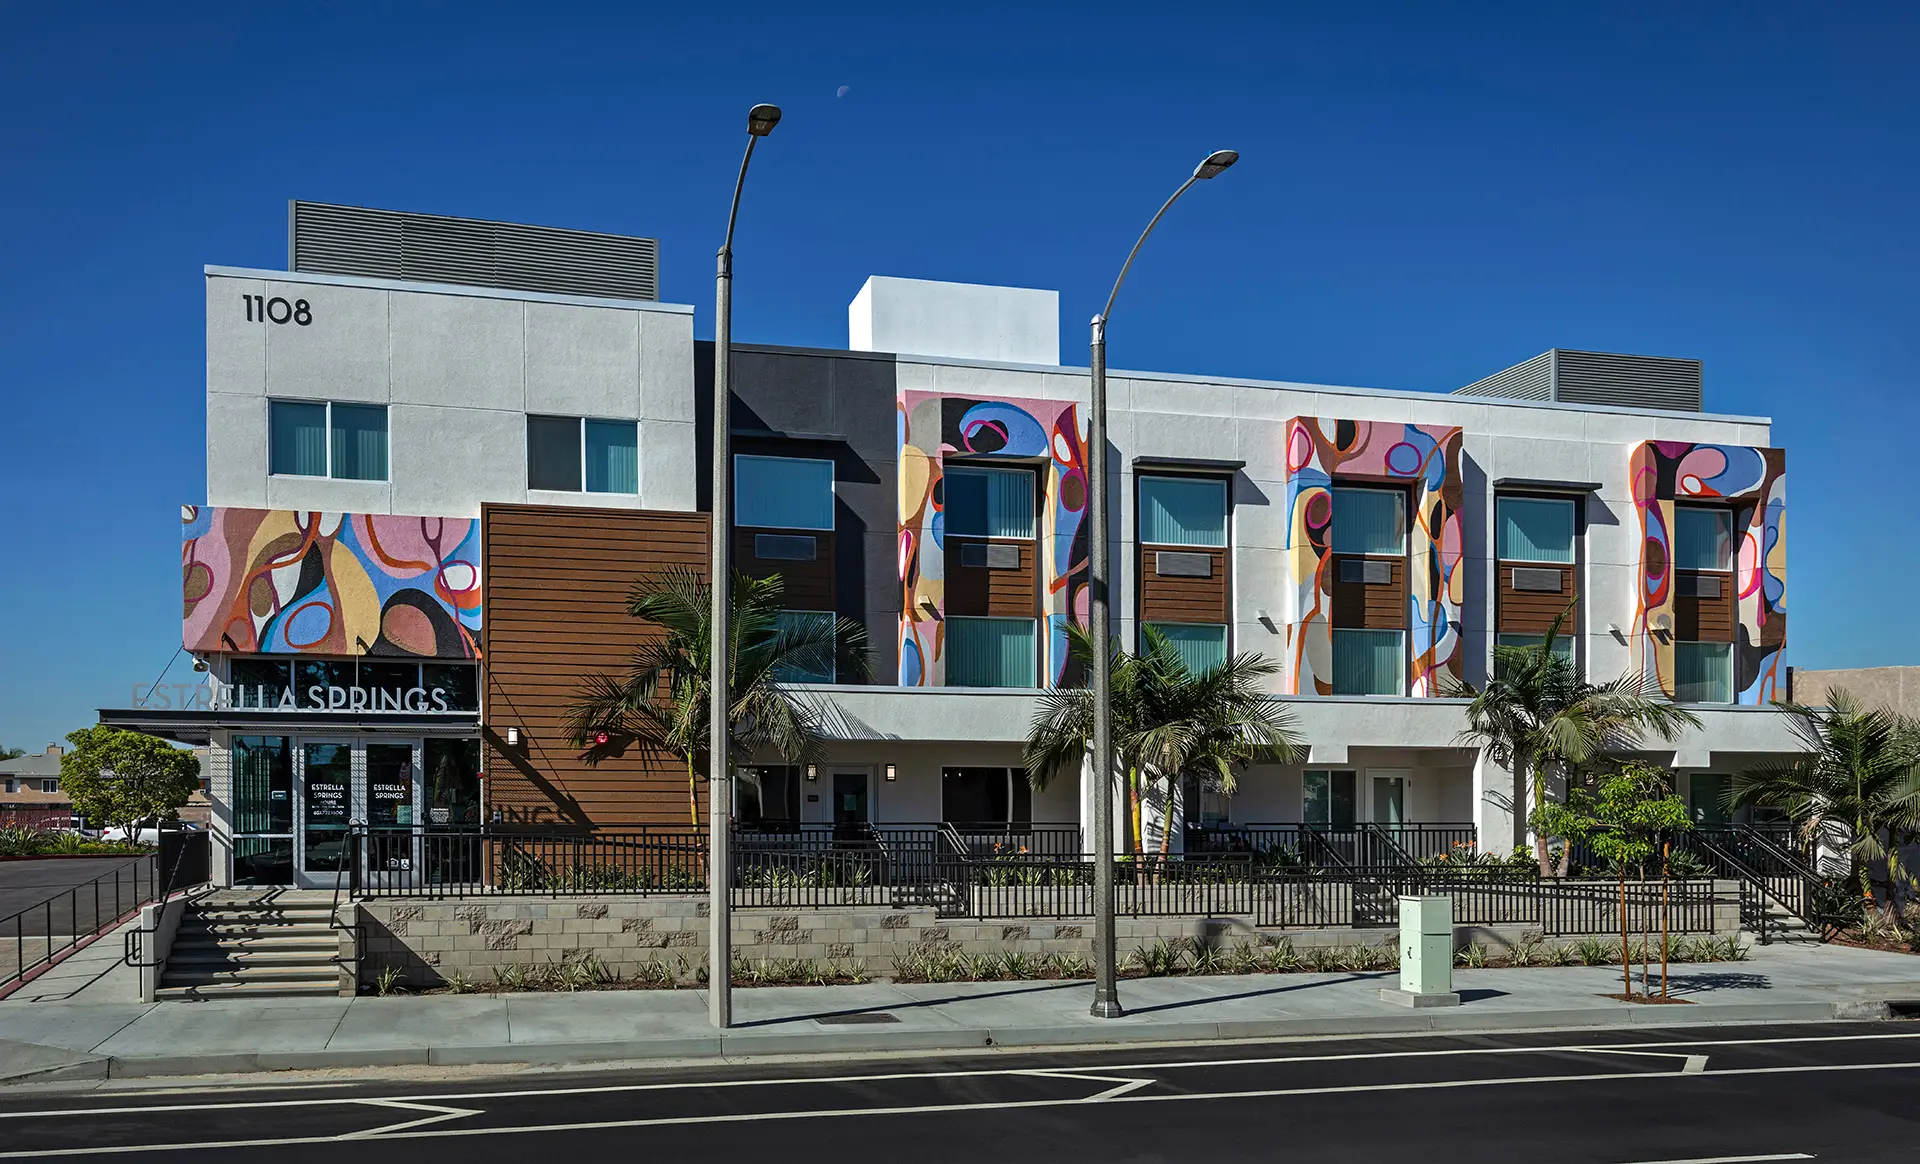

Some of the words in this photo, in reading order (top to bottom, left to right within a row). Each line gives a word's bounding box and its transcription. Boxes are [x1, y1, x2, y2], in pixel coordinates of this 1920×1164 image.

[243, 294, 313, 326] 1108
[131, 683, 299, 712] ESTRELLA
[307, 685, 448, 713] SPRINGS
[311, 783, 344, 791] ESTRELLA
[313, 791, 343, 799] SPRINGS
